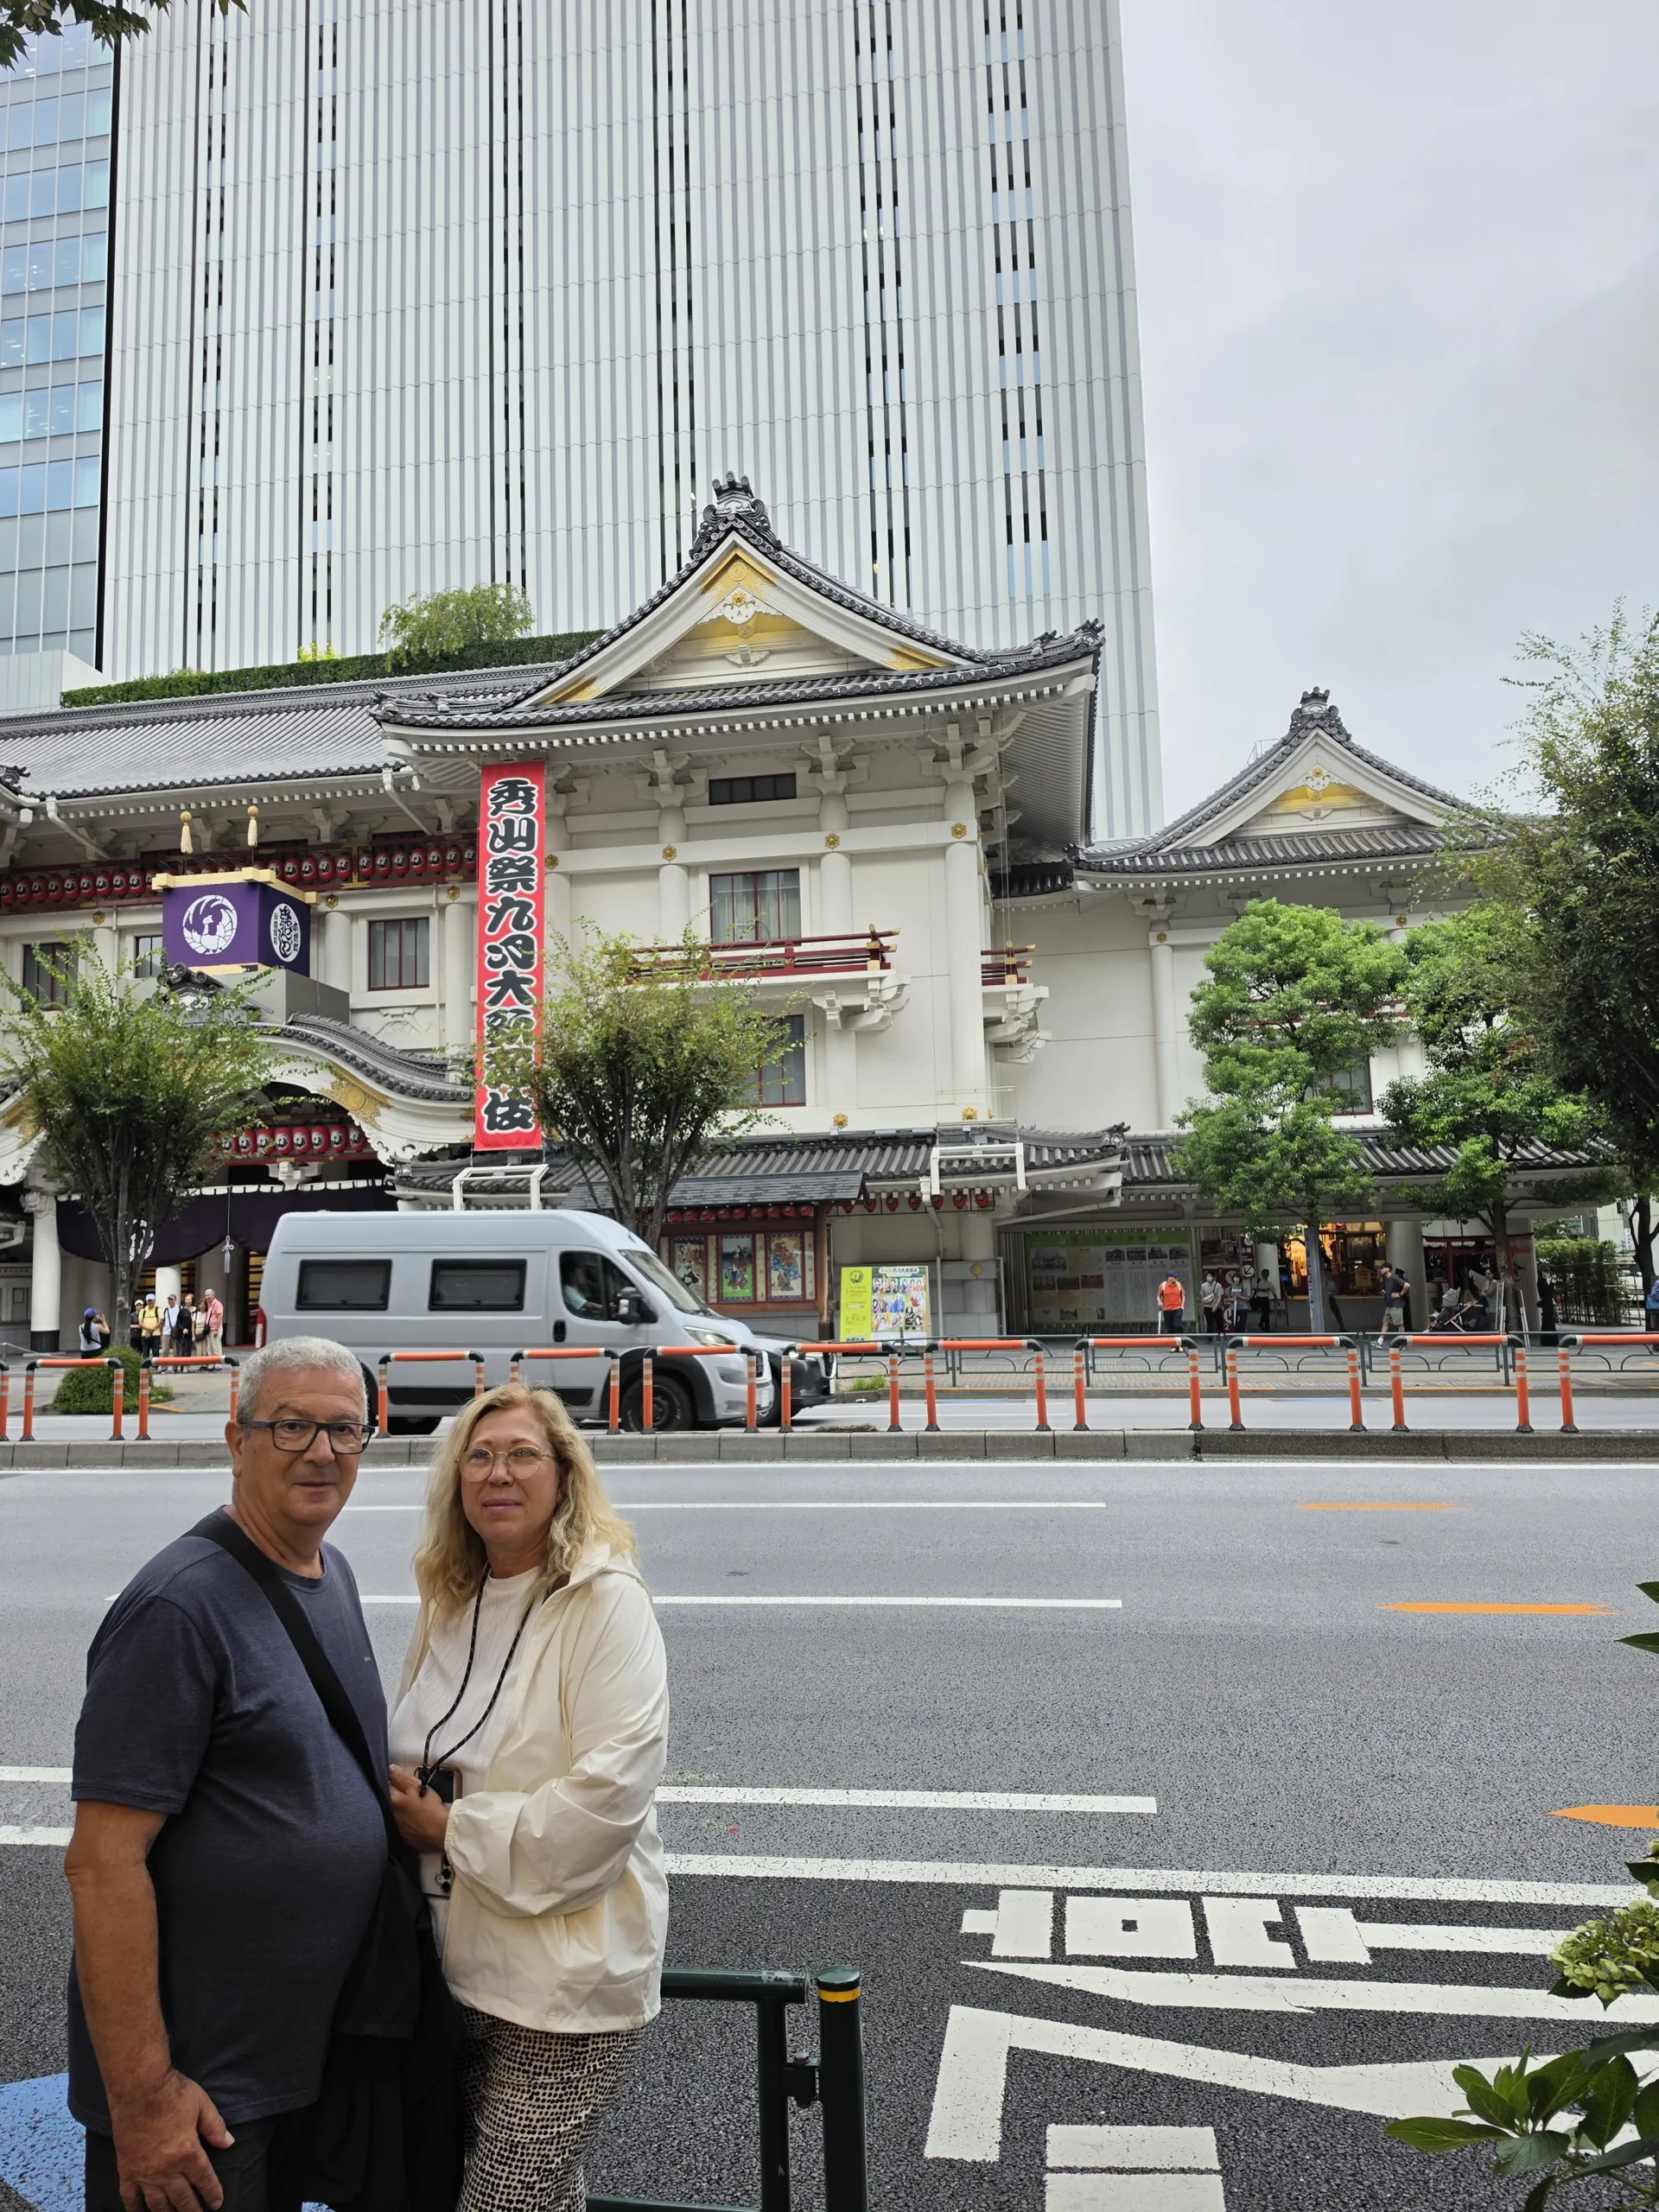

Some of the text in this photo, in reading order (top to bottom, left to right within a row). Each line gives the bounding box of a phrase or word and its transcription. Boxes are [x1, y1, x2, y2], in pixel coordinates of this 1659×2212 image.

[482, 778, 539, 1133] 秀山祭九月大歌伎
